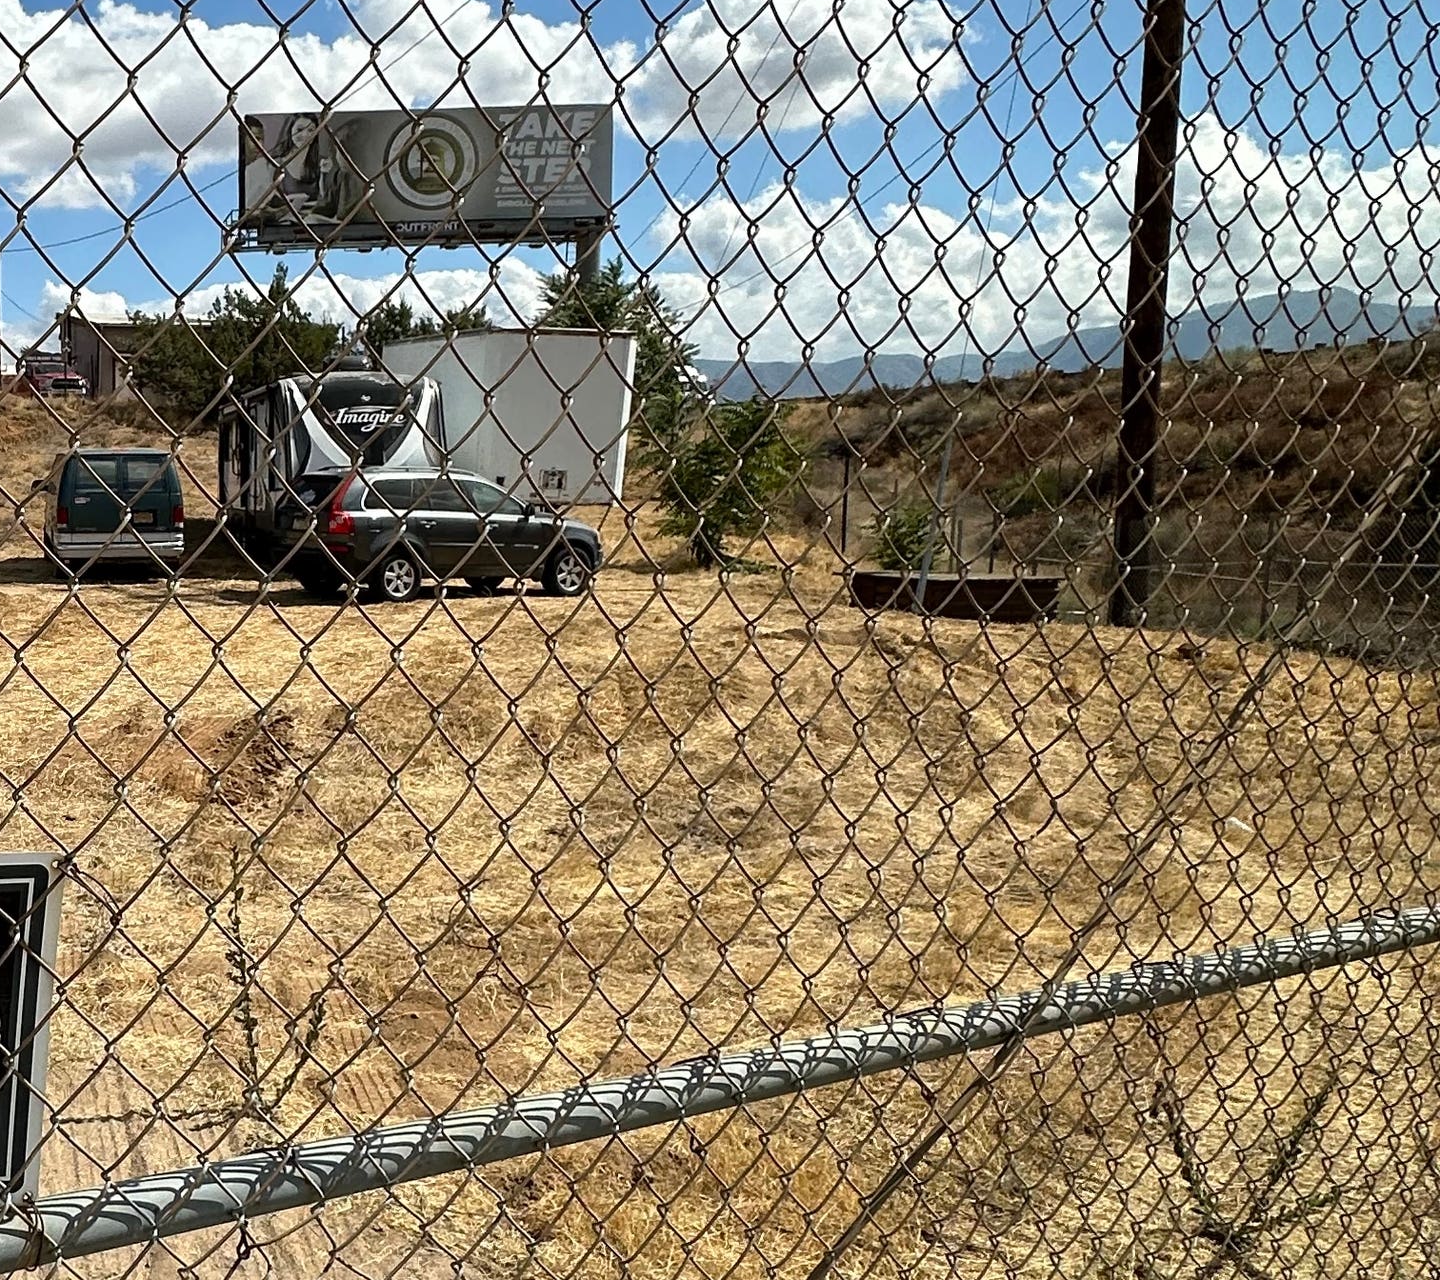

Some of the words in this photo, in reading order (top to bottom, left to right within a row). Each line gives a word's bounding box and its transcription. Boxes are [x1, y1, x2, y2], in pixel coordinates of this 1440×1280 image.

[499, 111, 596, 140] TAKE
[541, 139, 596, 156] NET
[497, 157, 592, 184] STEP
